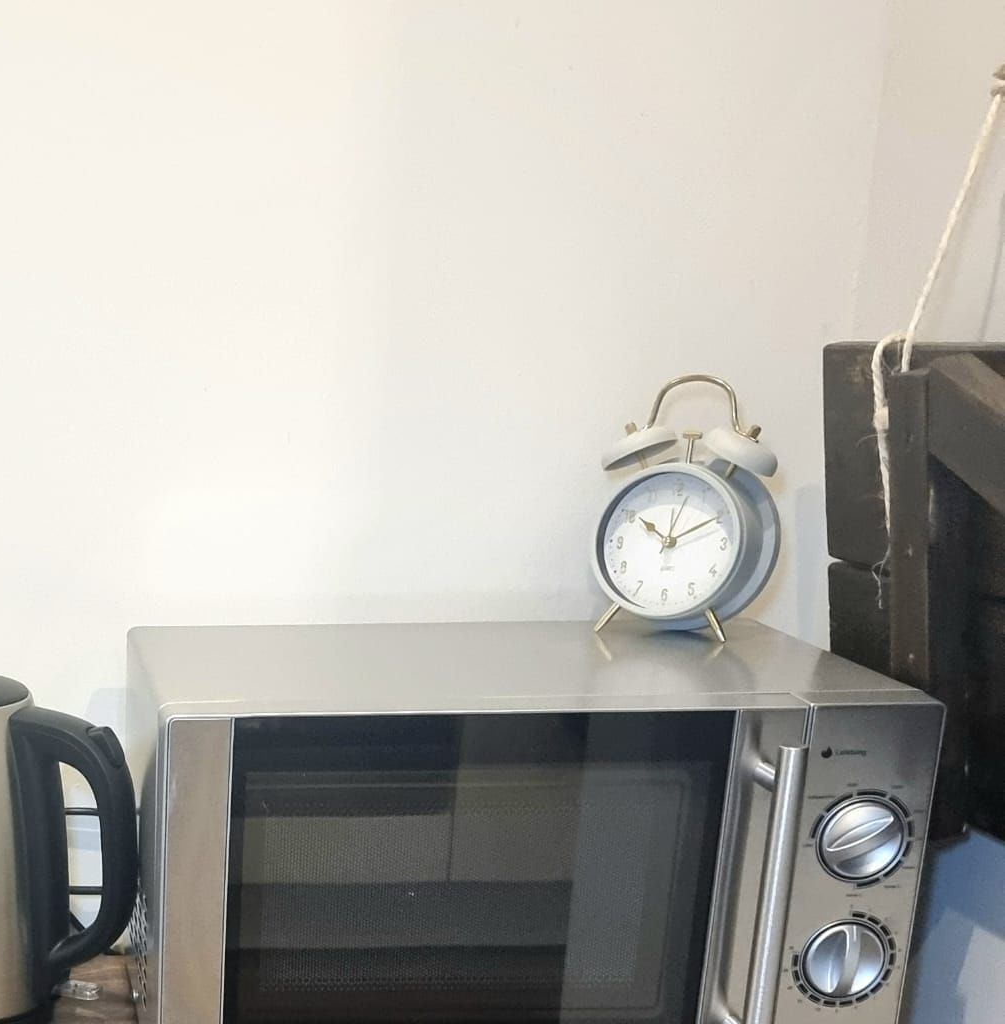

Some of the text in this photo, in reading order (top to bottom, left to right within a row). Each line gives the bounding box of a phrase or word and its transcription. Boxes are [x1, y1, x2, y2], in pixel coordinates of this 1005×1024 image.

[617, 536, 624, 549] 9
[720, 537, 728, 551] 3
[620, 561, 627, 574] 8
[709, 564, 717, 577] 4
[634, 580, 643, 596] 7
[661, 588, 668, 601] 6
[688, 582, 695, 596] 5
